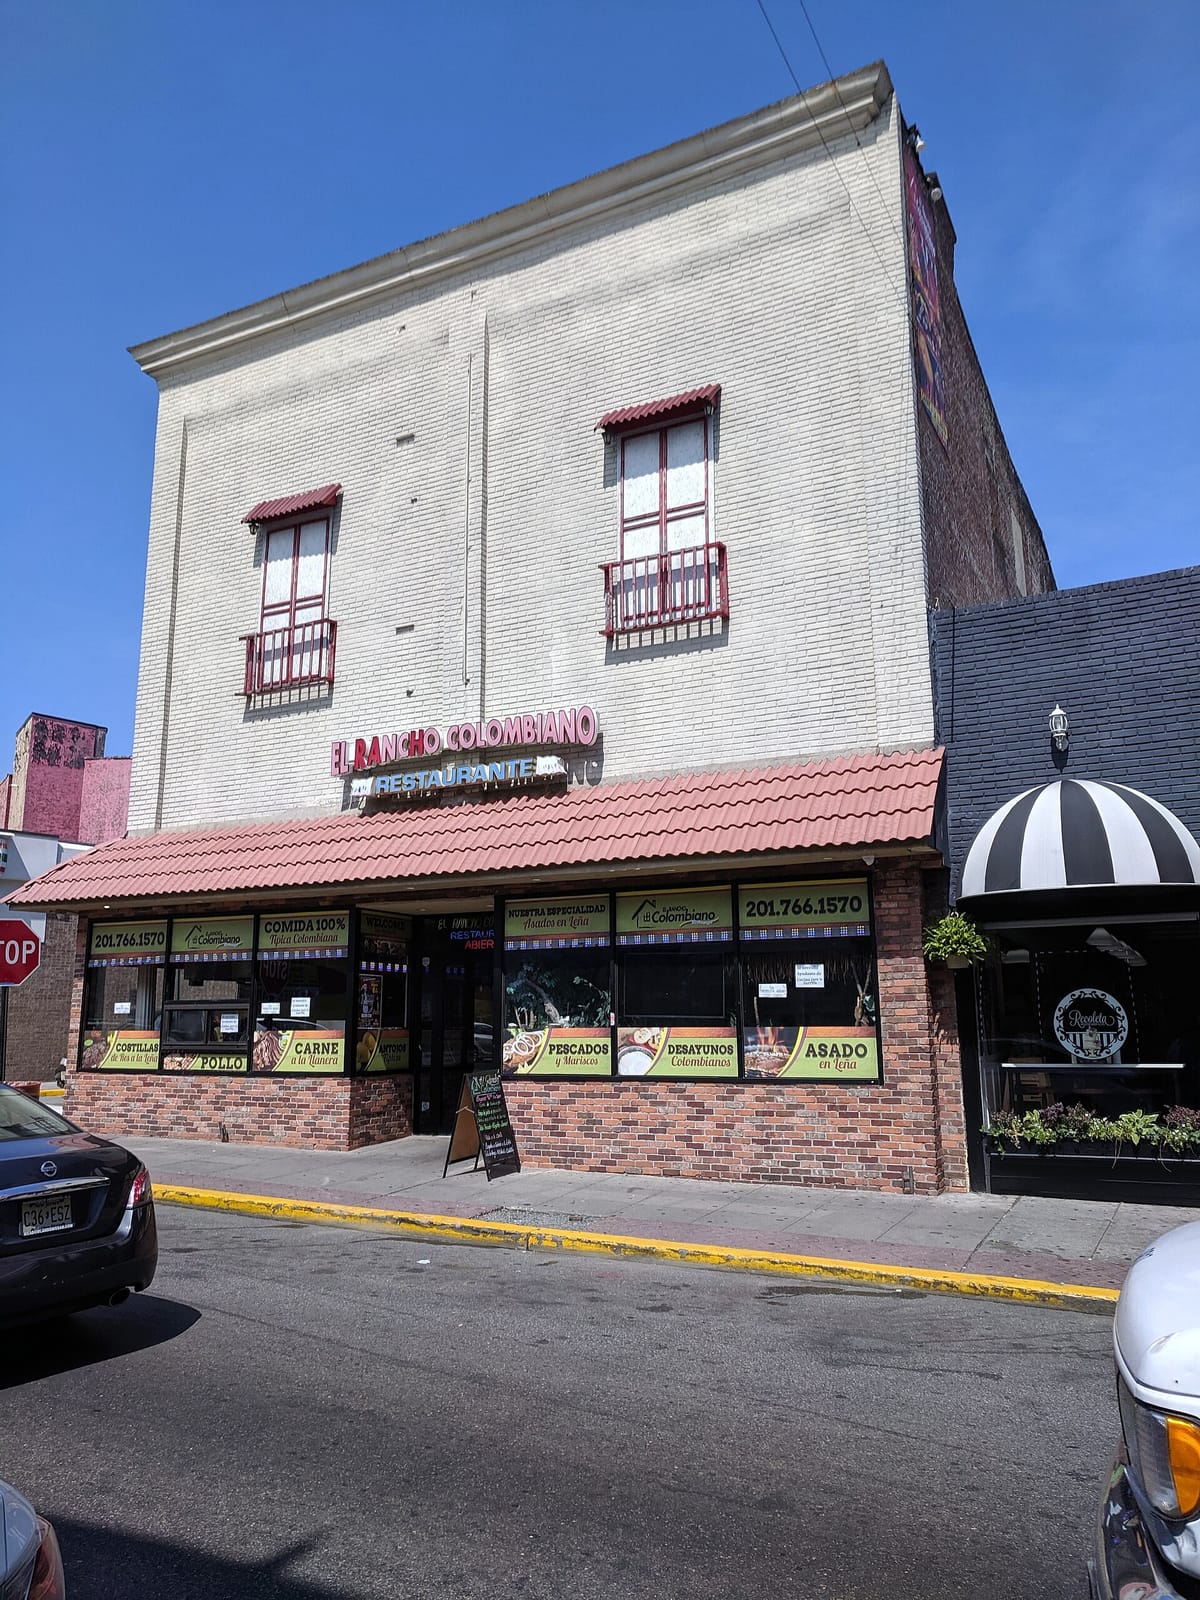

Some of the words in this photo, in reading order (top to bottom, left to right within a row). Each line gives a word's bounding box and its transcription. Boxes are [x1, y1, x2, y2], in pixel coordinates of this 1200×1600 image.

[331, 740, 350, 776] EL
[354, 727, 441, 771] RANCHO
[447, 706, 597, 750] COLOMBIANO
[376, 758, 534, 793] RESTAURANTE
[508, 906, 546, 918] NUESTRA
[547, 904, 606, 915] ESPECIALIDAD
[746, 896, 862, 917] 201.766.1570
[523, 917, 555, 930] Asados
[556, 919, 566, 927] en
[569, 915, 589, 929] Leña
[652, 909, 715, 923] Colombiano
[265, 919, 314, 933] COMIDA
[315, 917, 346, 931] 100%
[95, 932, 165, 948] 201.766.1570
[198, 933, 241, 945] Colombiano
[293, 933, 338, 944] Colombiana
[1068, 1009, 1115, 1029] Recoleta
[115, 1043, 159, 1052] COSTILLAS
[294, 1043, 339, 1055] CARNE
[549, 1043, 609, 1055] PESCADOS
[668, 1043, 734, 1055] DESAYUNOS
[805, 1043, 868, 1058] ASADO
[136, 1053, 143, 1062] la
[200, 1057, 243, 1069] POLLO
[291, 1057, 296, 1065] a
[298, 1054, 307, 1065] la
[308, 1054, 338, 1068] Llanera
[555, 1058, 561, 1067] y
[563, 1056, 599, 1065] Mariscos
[671, 1055, 731, 1067] Colombianos
[819, 1061, 831, 1070] en
[833, 1058, 857, 1072] Leña
[24, 1210, 44, 1227] C36
[51, 1205, 70, 1223] ESZ
